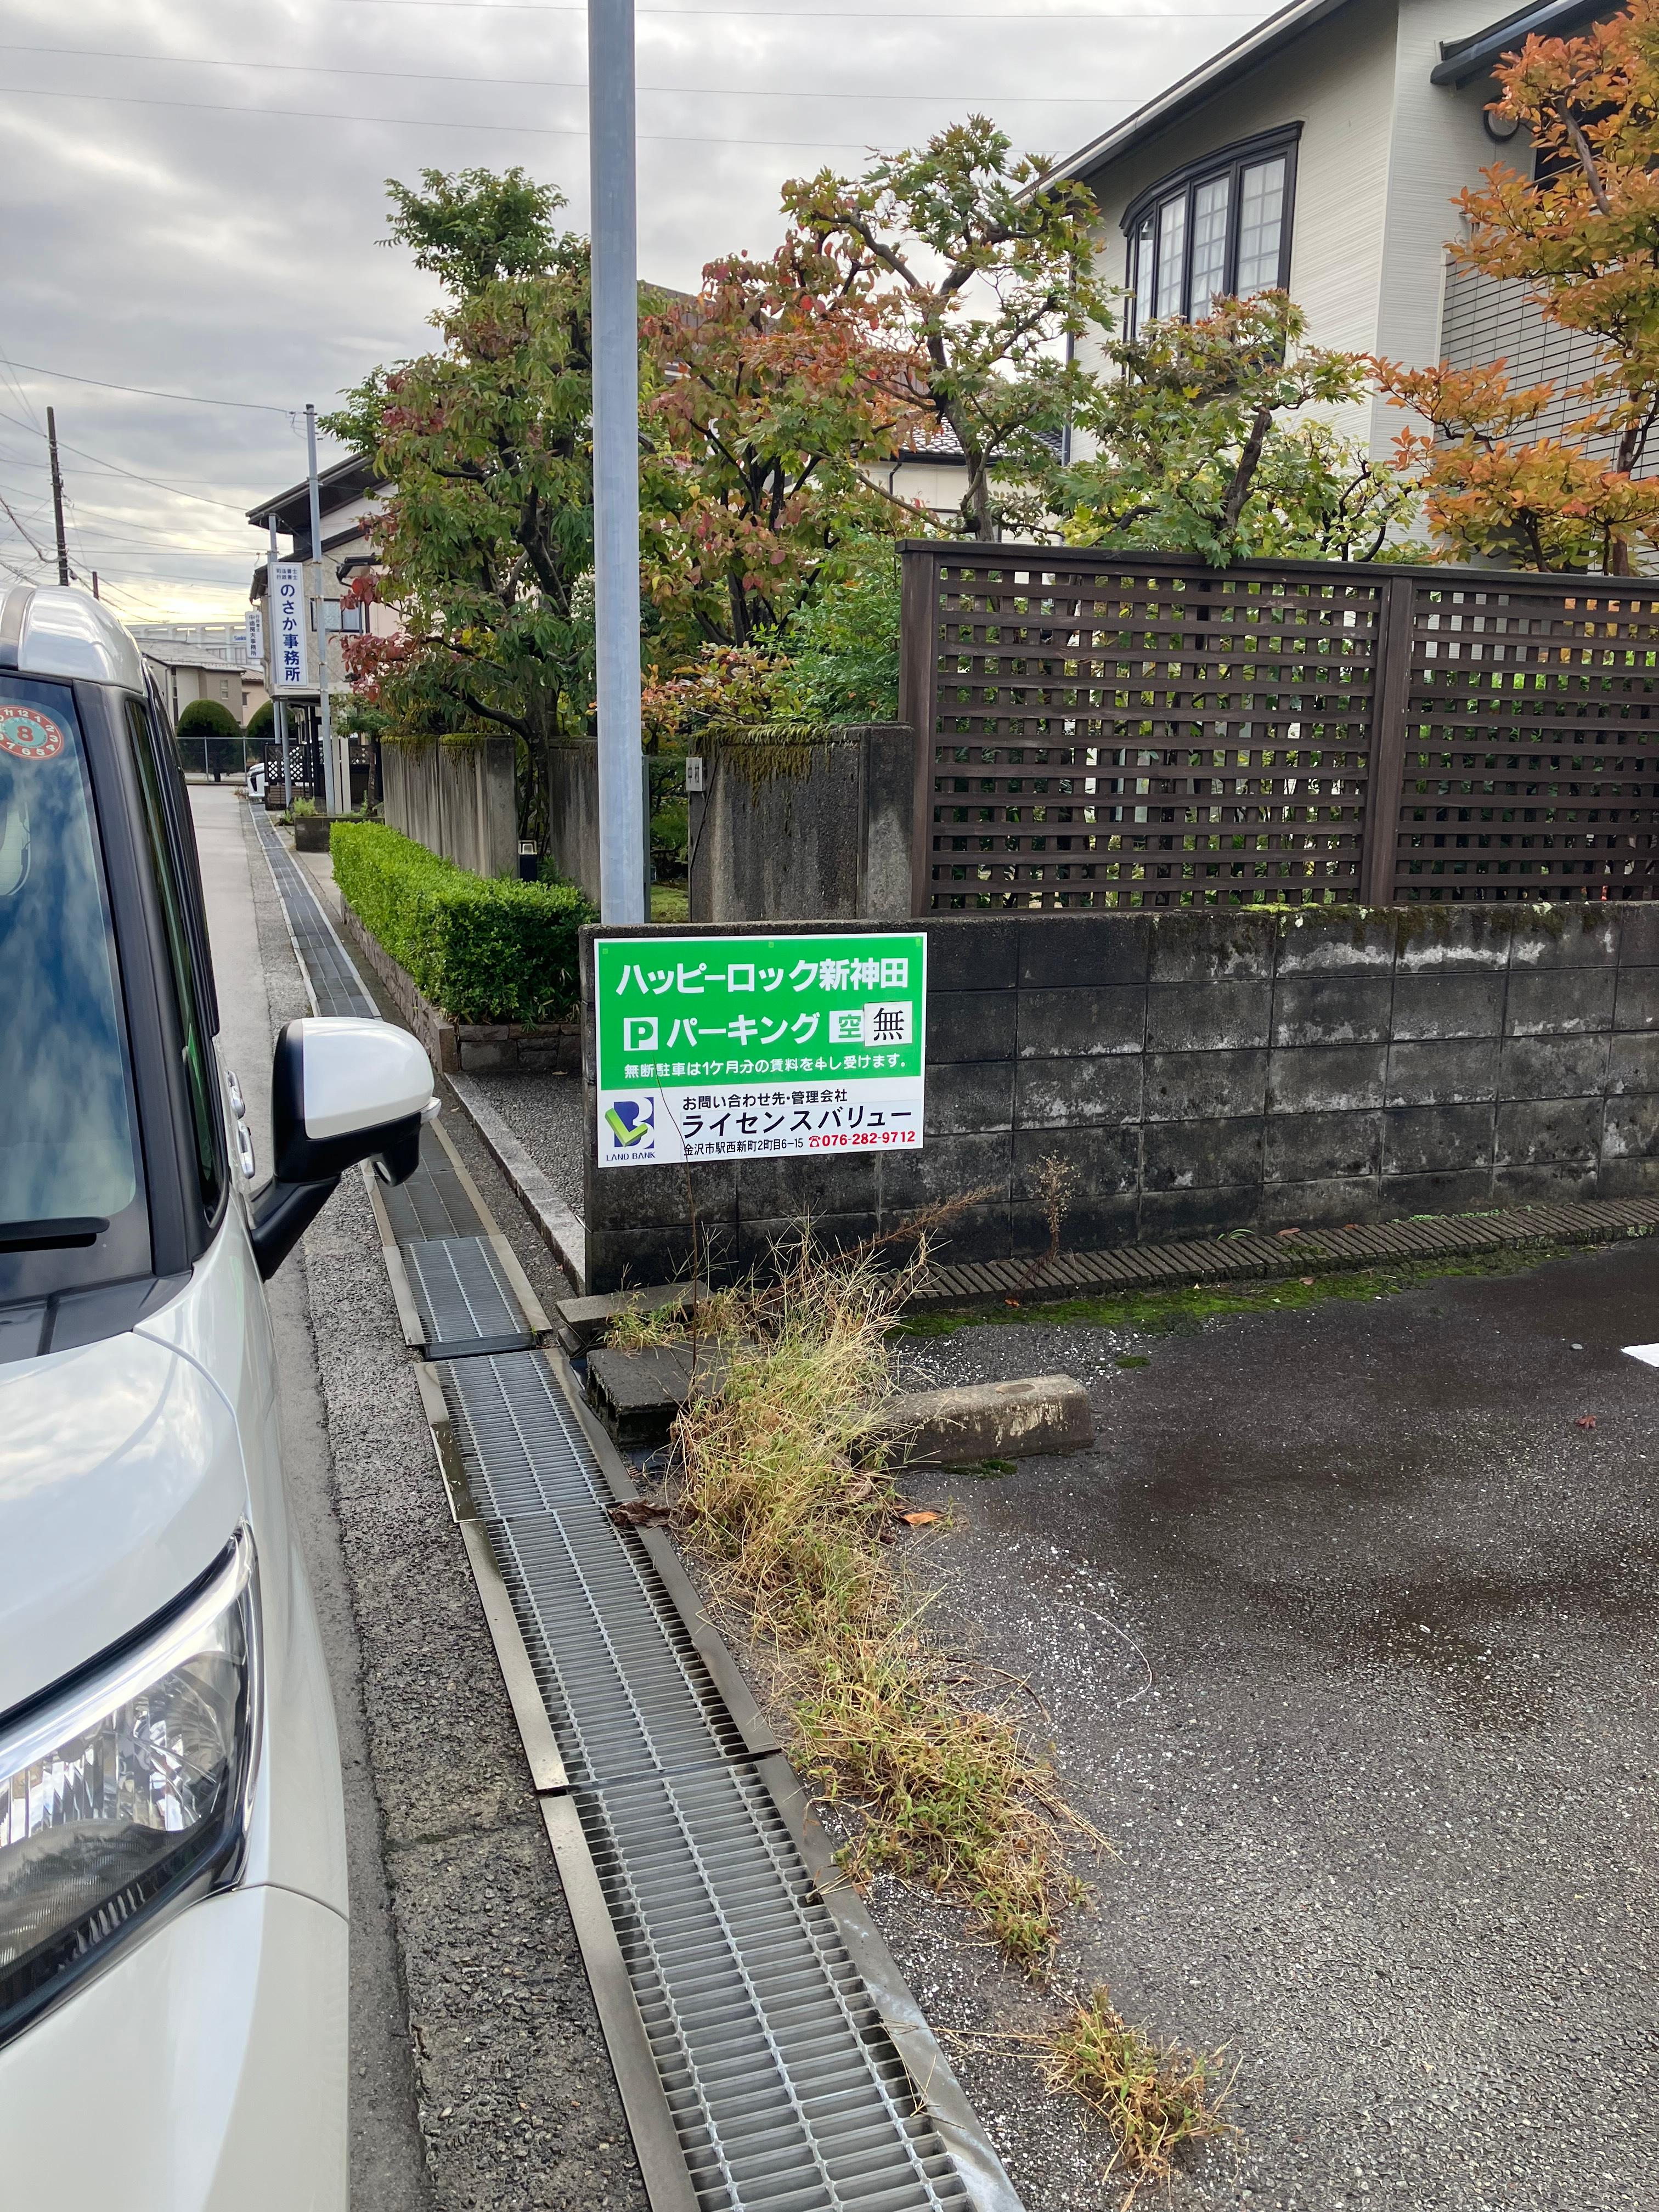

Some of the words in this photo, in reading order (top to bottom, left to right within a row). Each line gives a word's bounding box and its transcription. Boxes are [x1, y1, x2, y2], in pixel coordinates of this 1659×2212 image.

[280, 584, 300, 682] のさか事務所
[17, 725, 33, 742] 8
[616, 957, 908, 996] ハッピーロック新神田
[630, 1020, 654, 1049] P
[666, 1012, 821, 1048] パーキング
[838, 1014, 861, 1039] 空
[873, 1007, 905, 1041] 無
[683, 1105, 912, 1139] ライセンスバリュー
[822, 1130, 916, 1147] 076-282-9712
[606, 1153, 629, 1161] LAND
[632, 1152, 656, 1160] BANK
